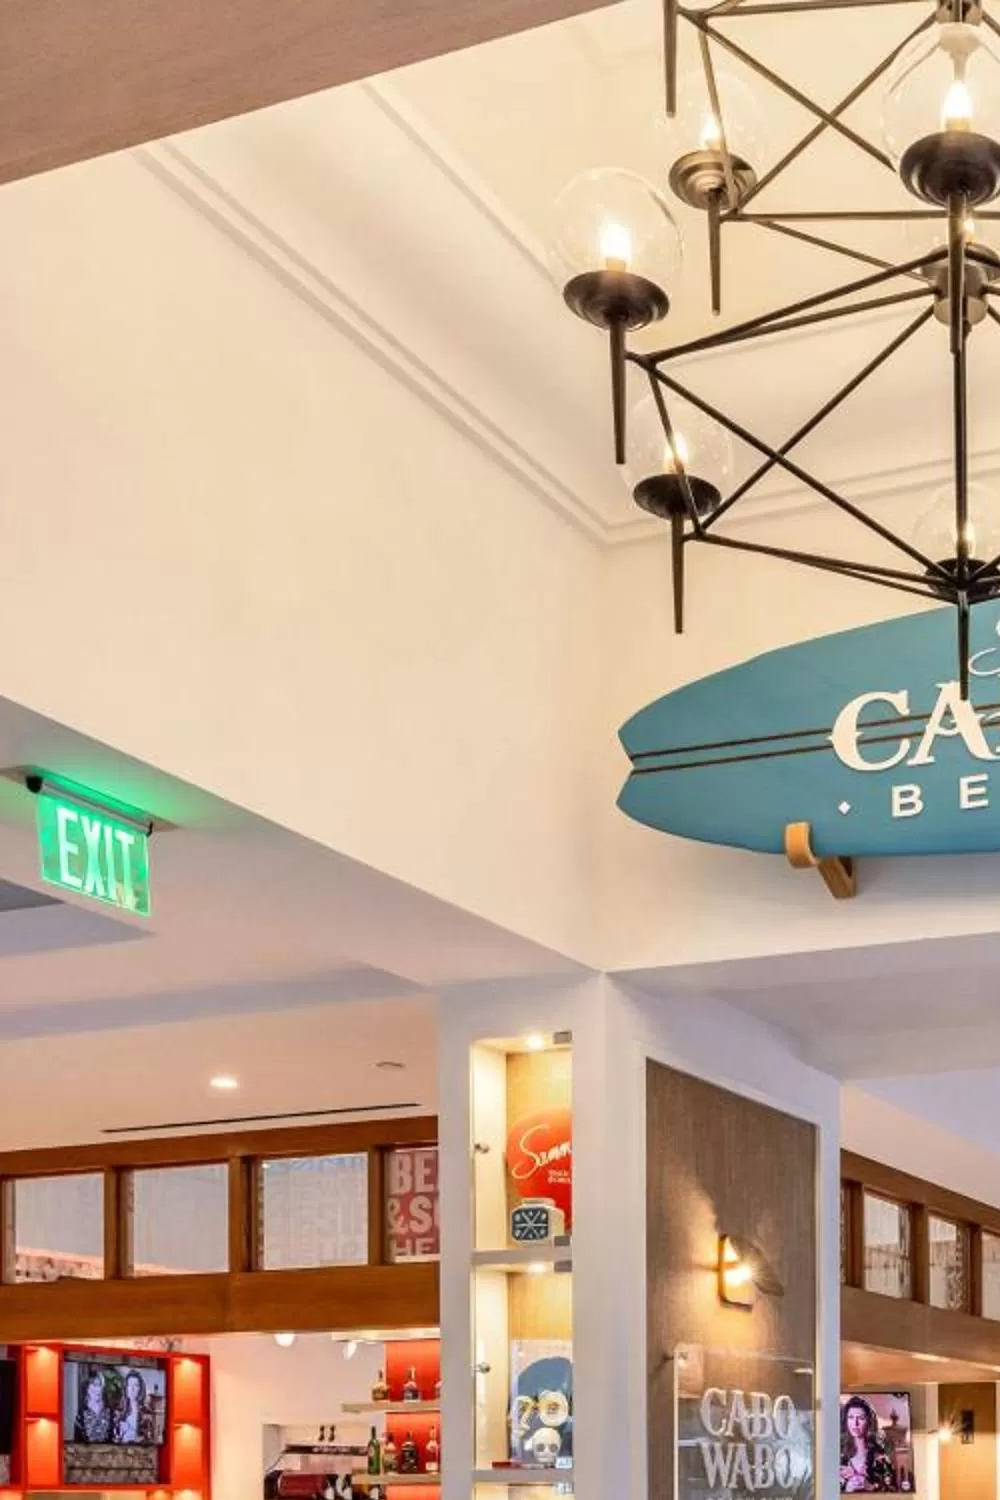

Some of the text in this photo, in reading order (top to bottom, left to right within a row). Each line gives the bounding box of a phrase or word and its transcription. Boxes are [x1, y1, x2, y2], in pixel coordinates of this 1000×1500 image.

[56, 807, 137, 908] EXIT
[701, 1387, 796, 1440] CABO
[700, 1440, 797, 1491] WABO
